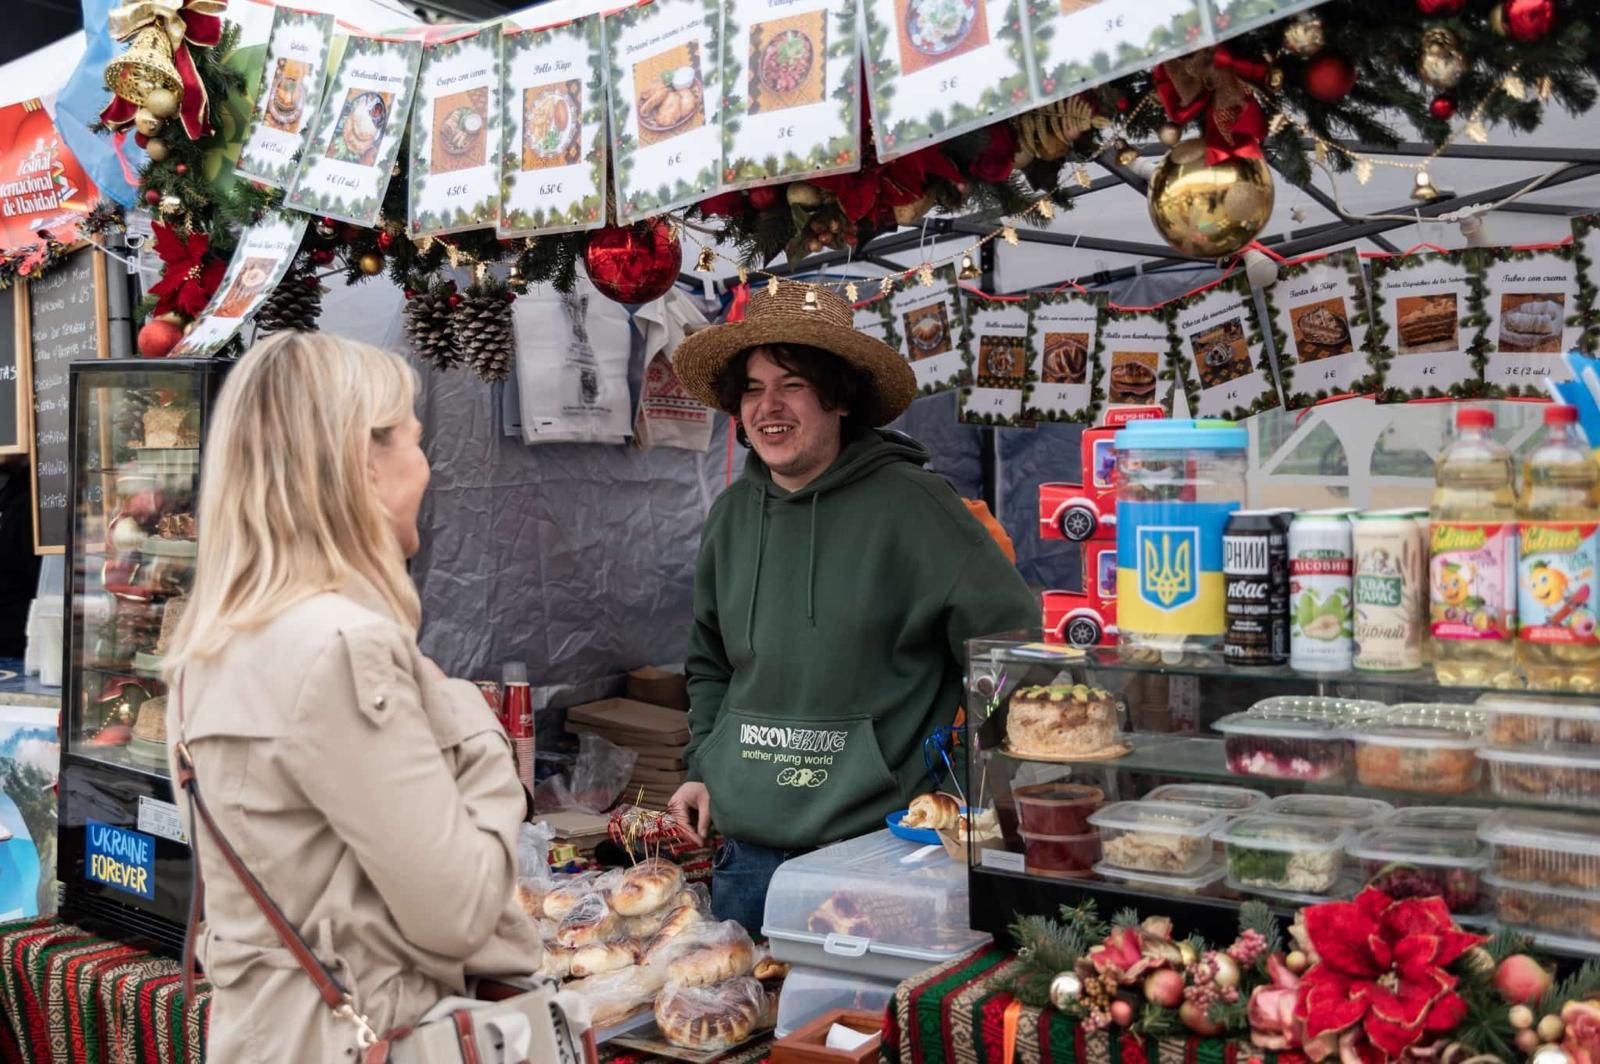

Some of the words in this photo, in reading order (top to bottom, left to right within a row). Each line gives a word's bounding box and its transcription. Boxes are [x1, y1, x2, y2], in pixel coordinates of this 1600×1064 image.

[3, 199, 17, 217] de
[16, 191, 58, 214] Navidad
[1501, 274, 1526, 283] Tubos
[1227, 580, 1268, 599] квас
[1360, 579, 1396, 591] КВАС
[740, 723, 848, 752] DISCOVERING
[742, 749, 772, 761] another
[773, 753, 802, 766] young
[804, 755, 834, 766] world
[91, 825, 149, 865] UKRAINE
[91, 853, 148, 894] FOREVER
